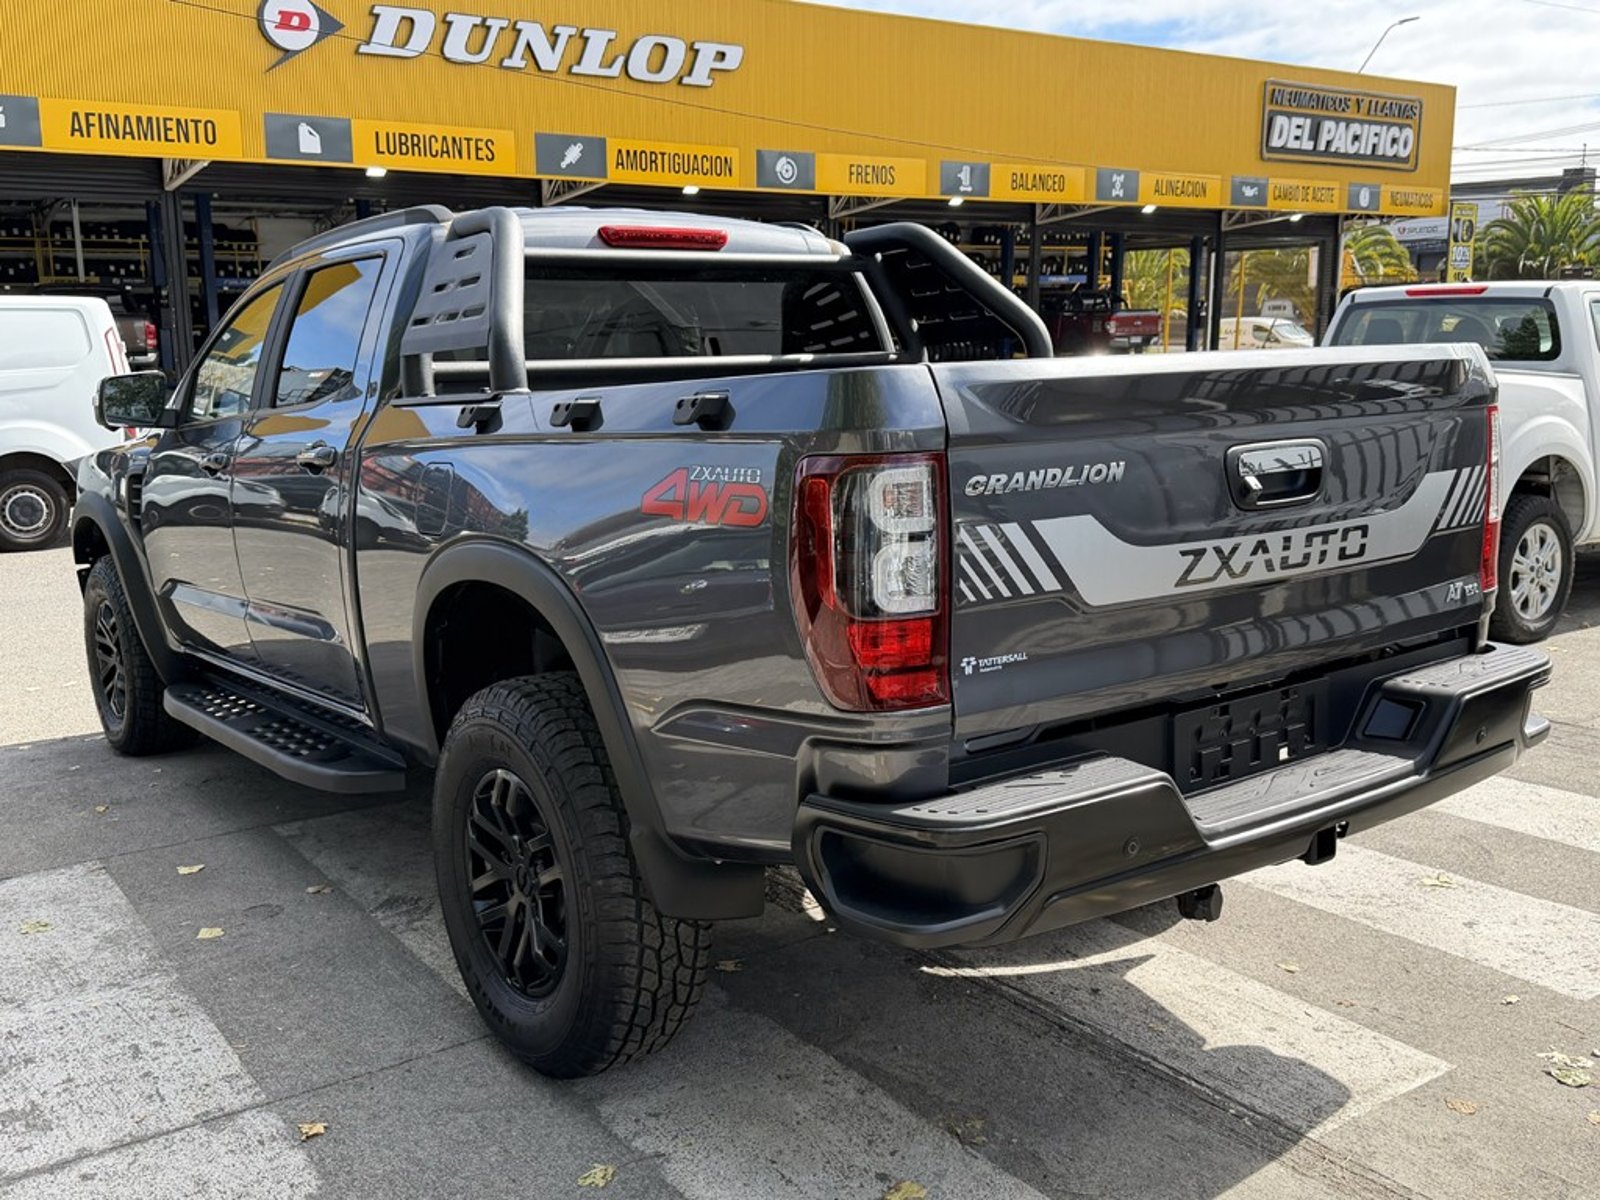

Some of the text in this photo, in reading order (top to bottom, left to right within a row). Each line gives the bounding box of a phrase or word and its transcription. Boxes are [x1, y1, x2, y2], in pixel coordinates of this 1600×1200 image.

[275, 10, 311, 31] D
[358, 4, 744, 87] DUNLOP
[1272, 88, 1418, 119] NEUMATICOS Y LLANTAS
[70, 111, 217, 145] AFINAMIENTO
[1269, 115, 1414, 158] DEL PACIFICO
[375, 130, 495, 162] LUBRICANTES
[615, 148, 733, 177] AMORTIGUACION
[848, 164, 896, 186] FRENOS
[1011, 172, 1065, 193] BALANCEO
[1153, 178, 1207, 198] ALINEACION
[1273, 185, 1335, 203] CAMBIO DE ACEITE
[1390, 191, 1434, 209] NEUMATICOS
[690, 466, 761, 483] ZXAUTO
[964, 461, 1126, 496] GRANDLION
[641, 467, 769, 528] 4WD
[1174, 524, 1369, 588] ZXAUTO
[978, 652, 1028, 667] TATTERSALL
